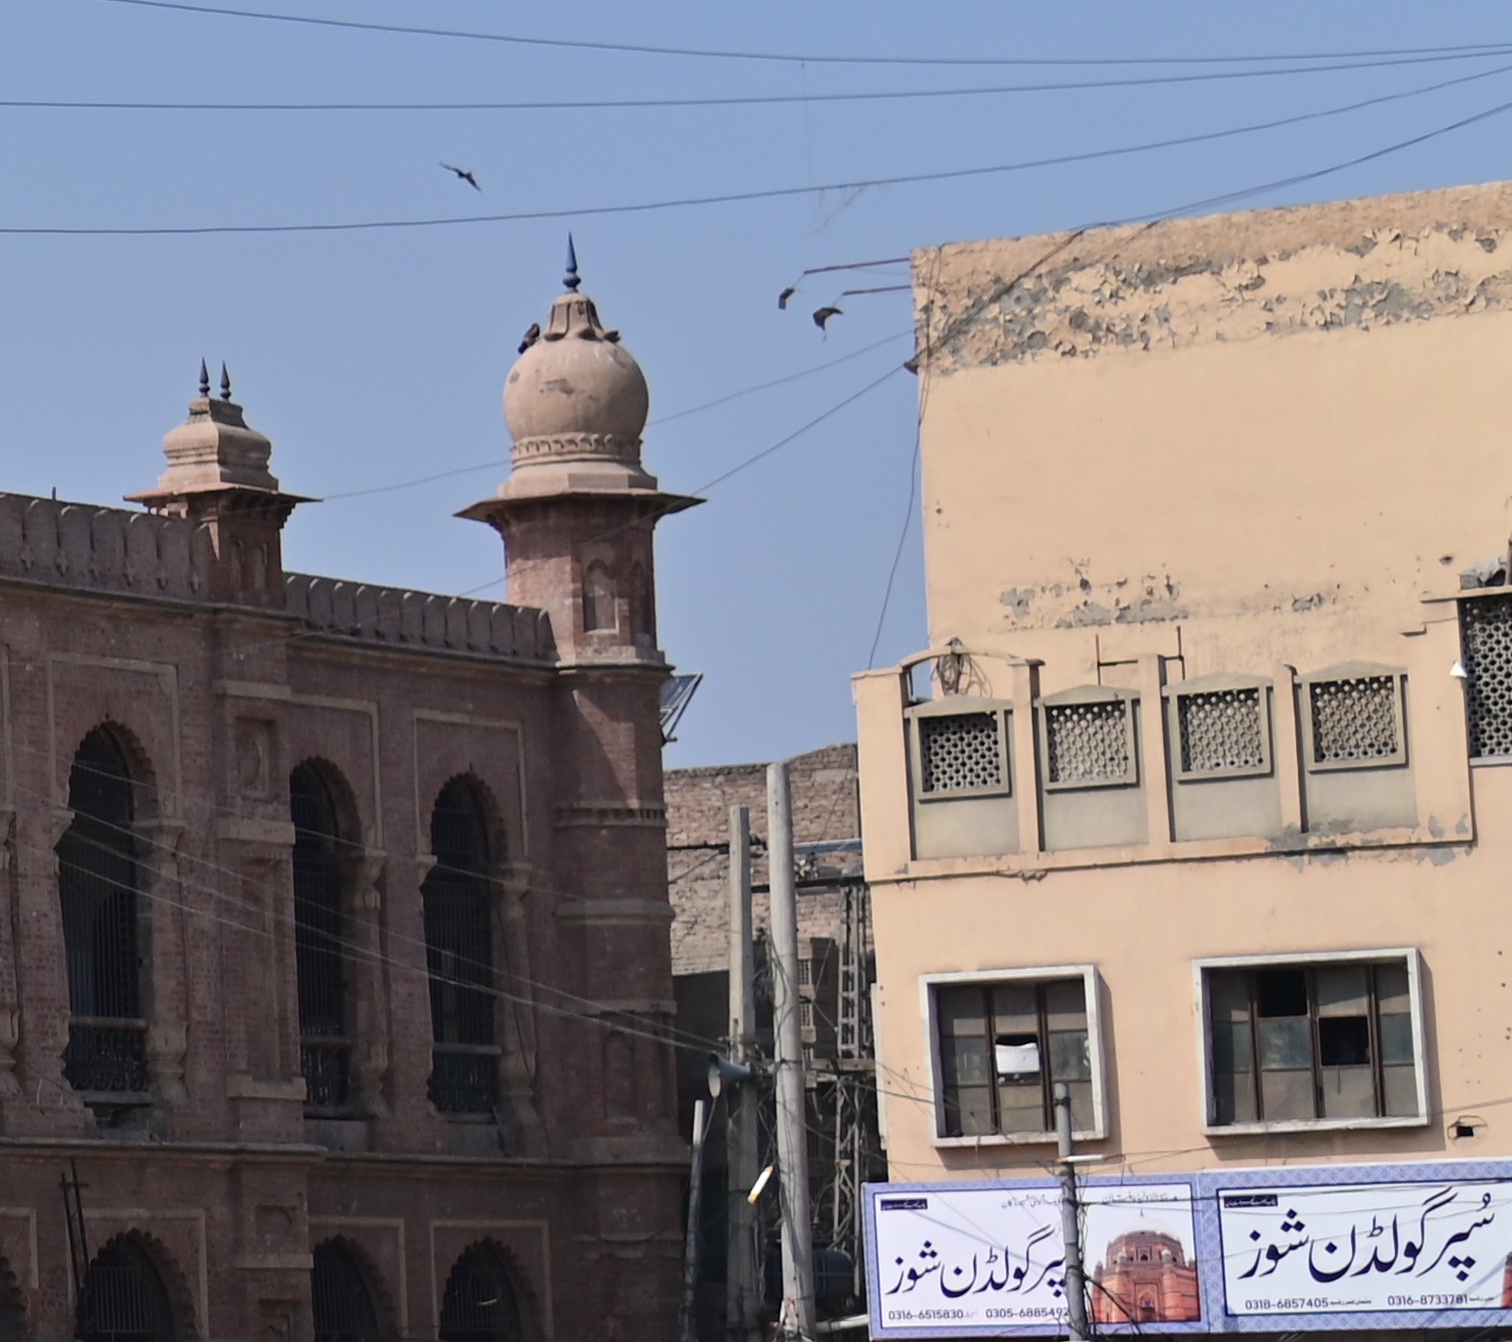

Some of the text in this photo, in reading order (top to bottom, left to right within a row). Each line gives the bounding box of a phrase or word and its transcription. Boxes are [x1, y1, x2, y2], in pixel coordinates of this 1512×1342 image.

[940, 1223, 1056, 1299] گولڈن
[1237, 1208, 1310, 1280] شوز
[1308, 1186, 1458, 1283] گولڈن
[885, 1240, 942, 1295] شوز
[888, 1309, 963, 1320] 0316-6515830
[1245, 1297, 1329, 1310] 0318-6857405
[1388, 1294, 1468, 1306] 0316-8733781
